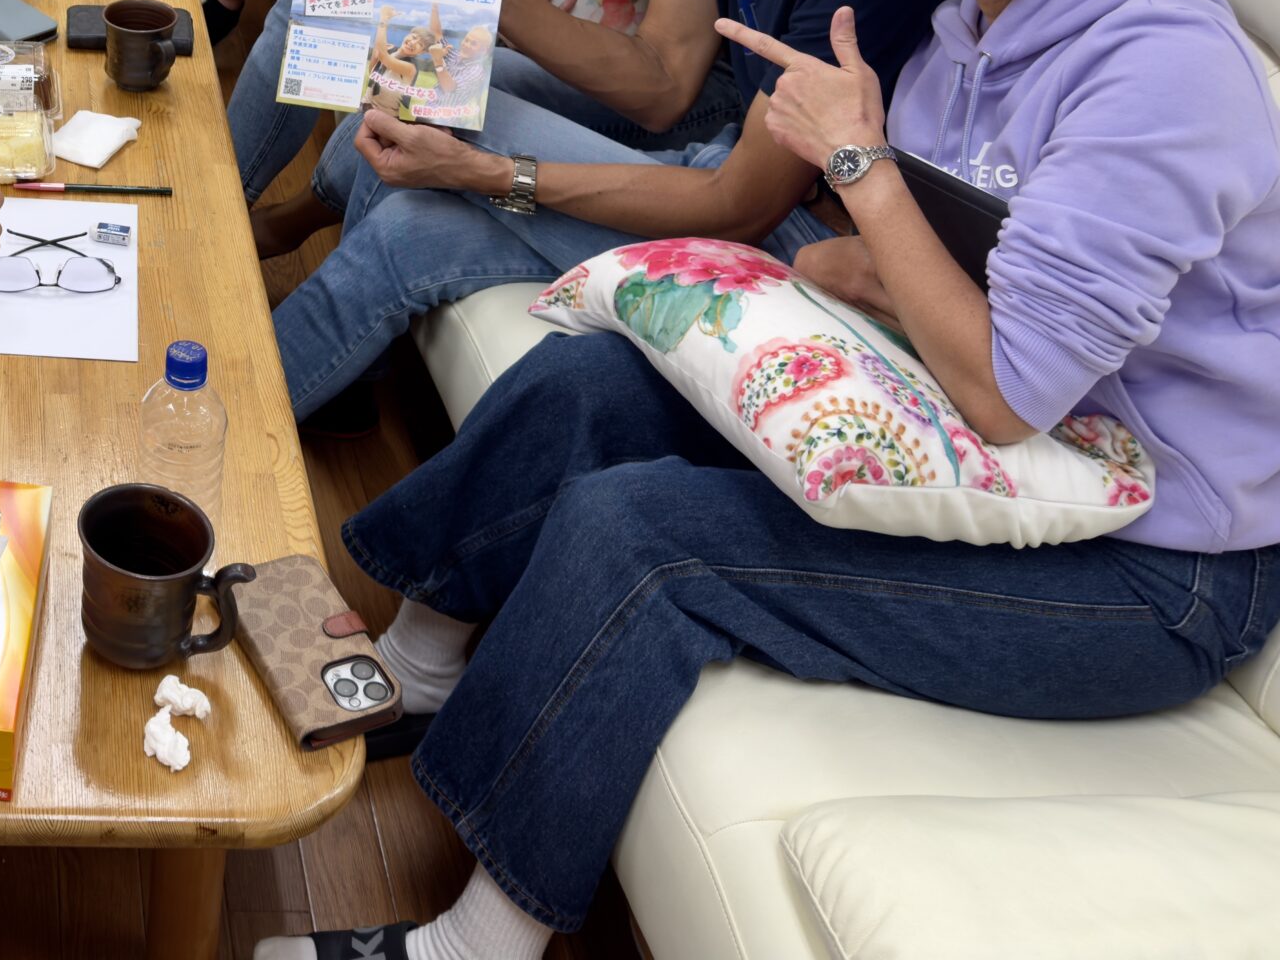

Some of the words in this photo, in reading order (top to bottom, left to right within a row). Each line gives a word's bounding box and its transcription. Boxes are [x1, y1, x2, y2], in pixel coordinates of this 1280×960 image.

[369, 72, 437, 99] ハッピーになる
